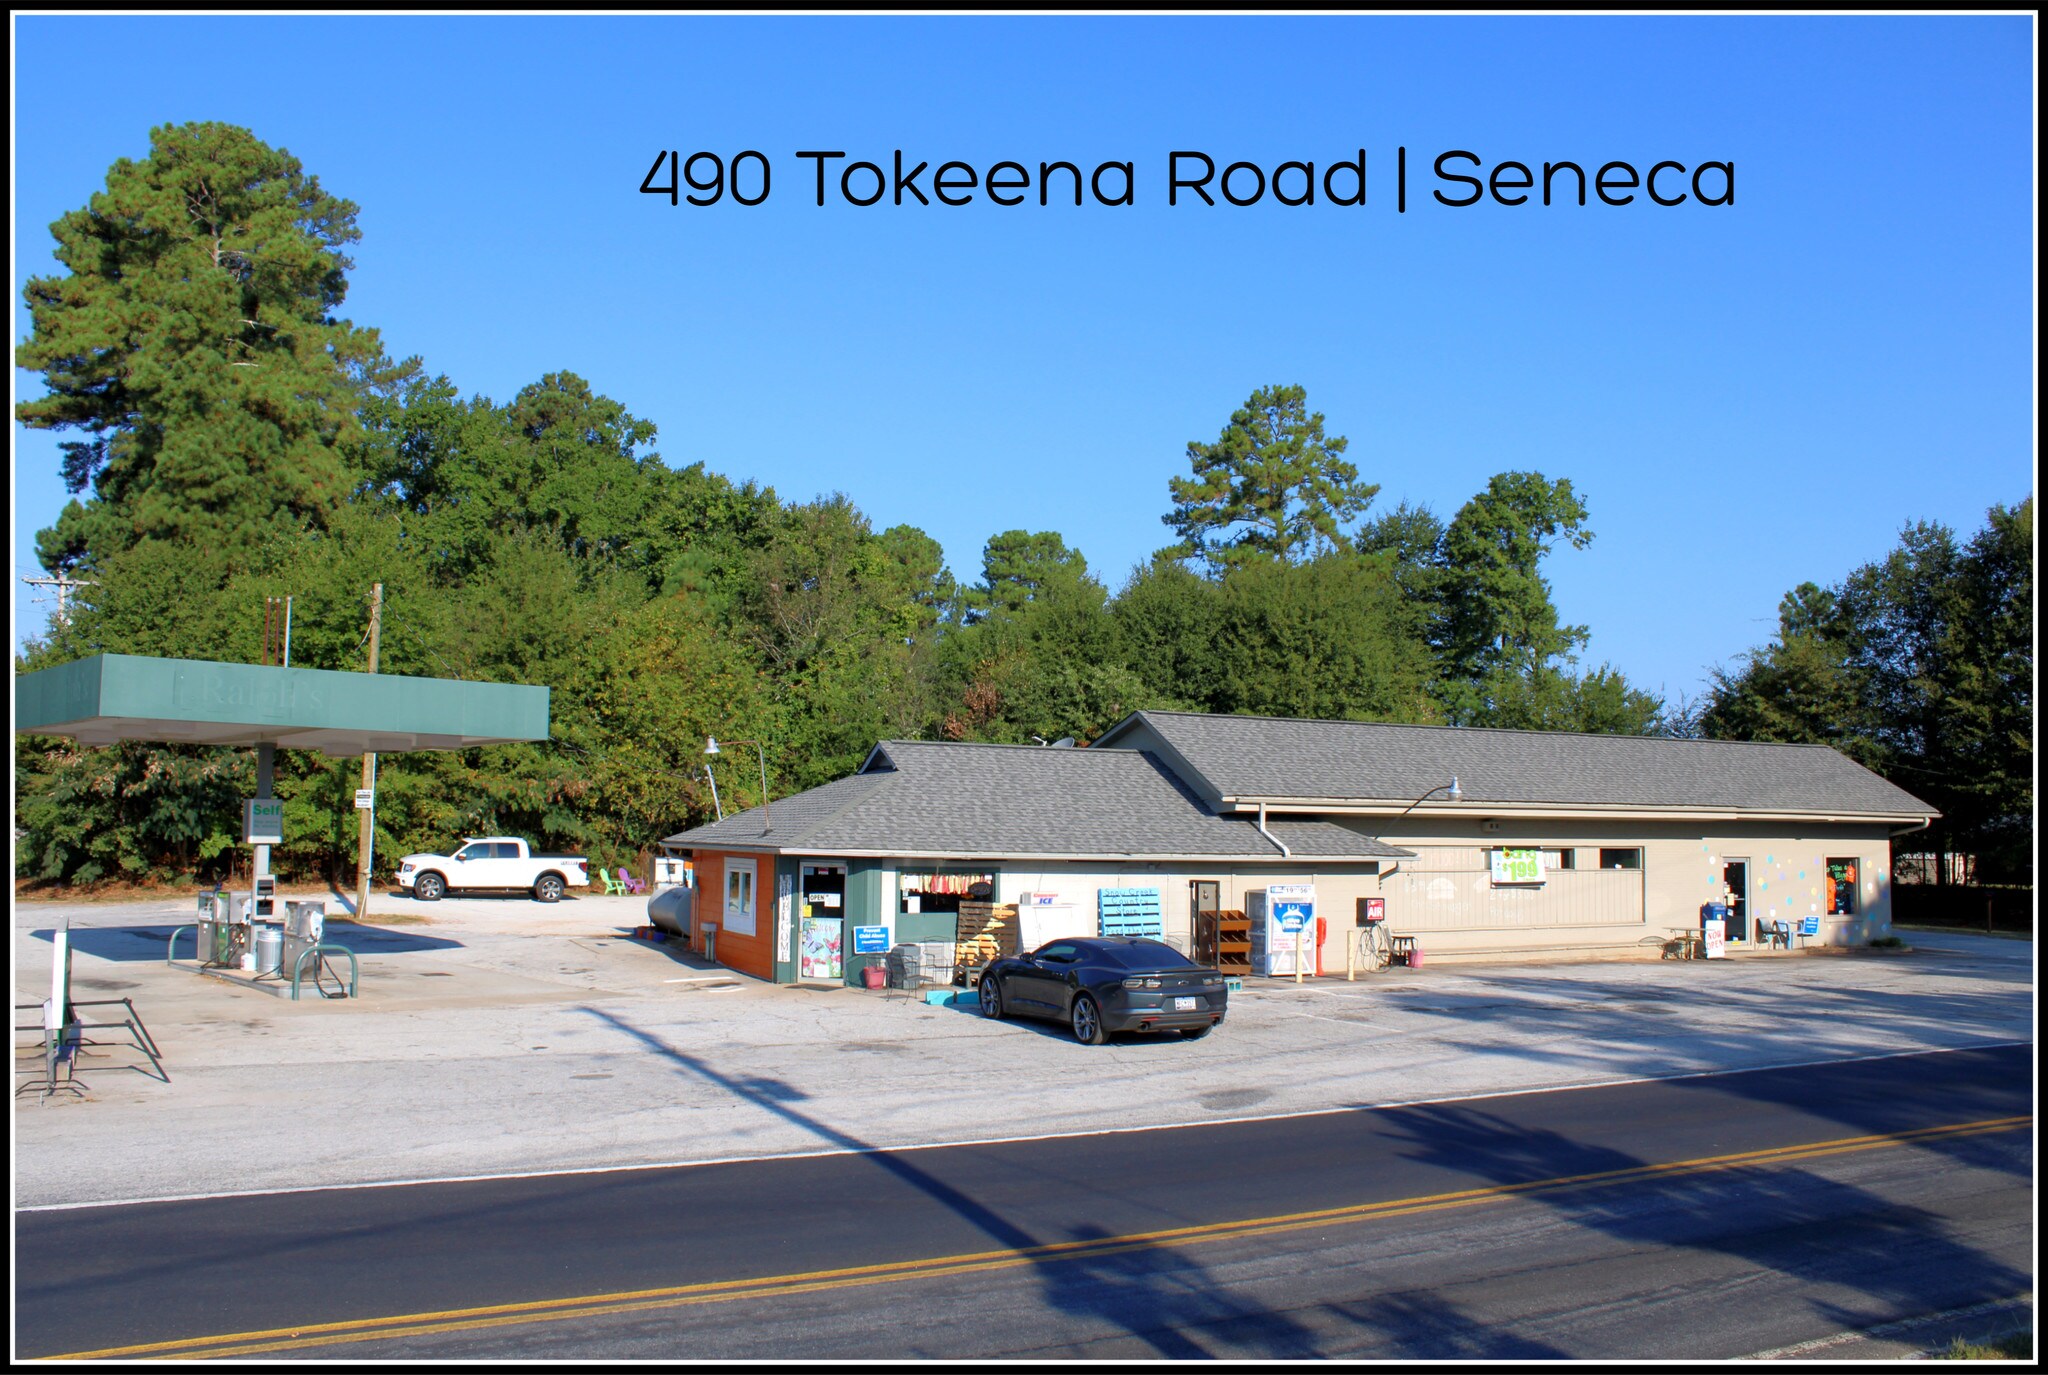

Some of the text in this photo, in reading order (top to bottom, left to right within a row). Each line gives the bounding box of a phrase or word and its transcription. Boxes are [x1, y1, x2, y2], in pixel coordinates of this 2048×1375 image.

[253, 804, 281, 816] Self
[1112, 897, 1149, 910] Country
[1368, 906, 1383, 917] AIR
[1707, 930, 1722, 940] NOW
[1706, 940, 1723, 950] OPEN
